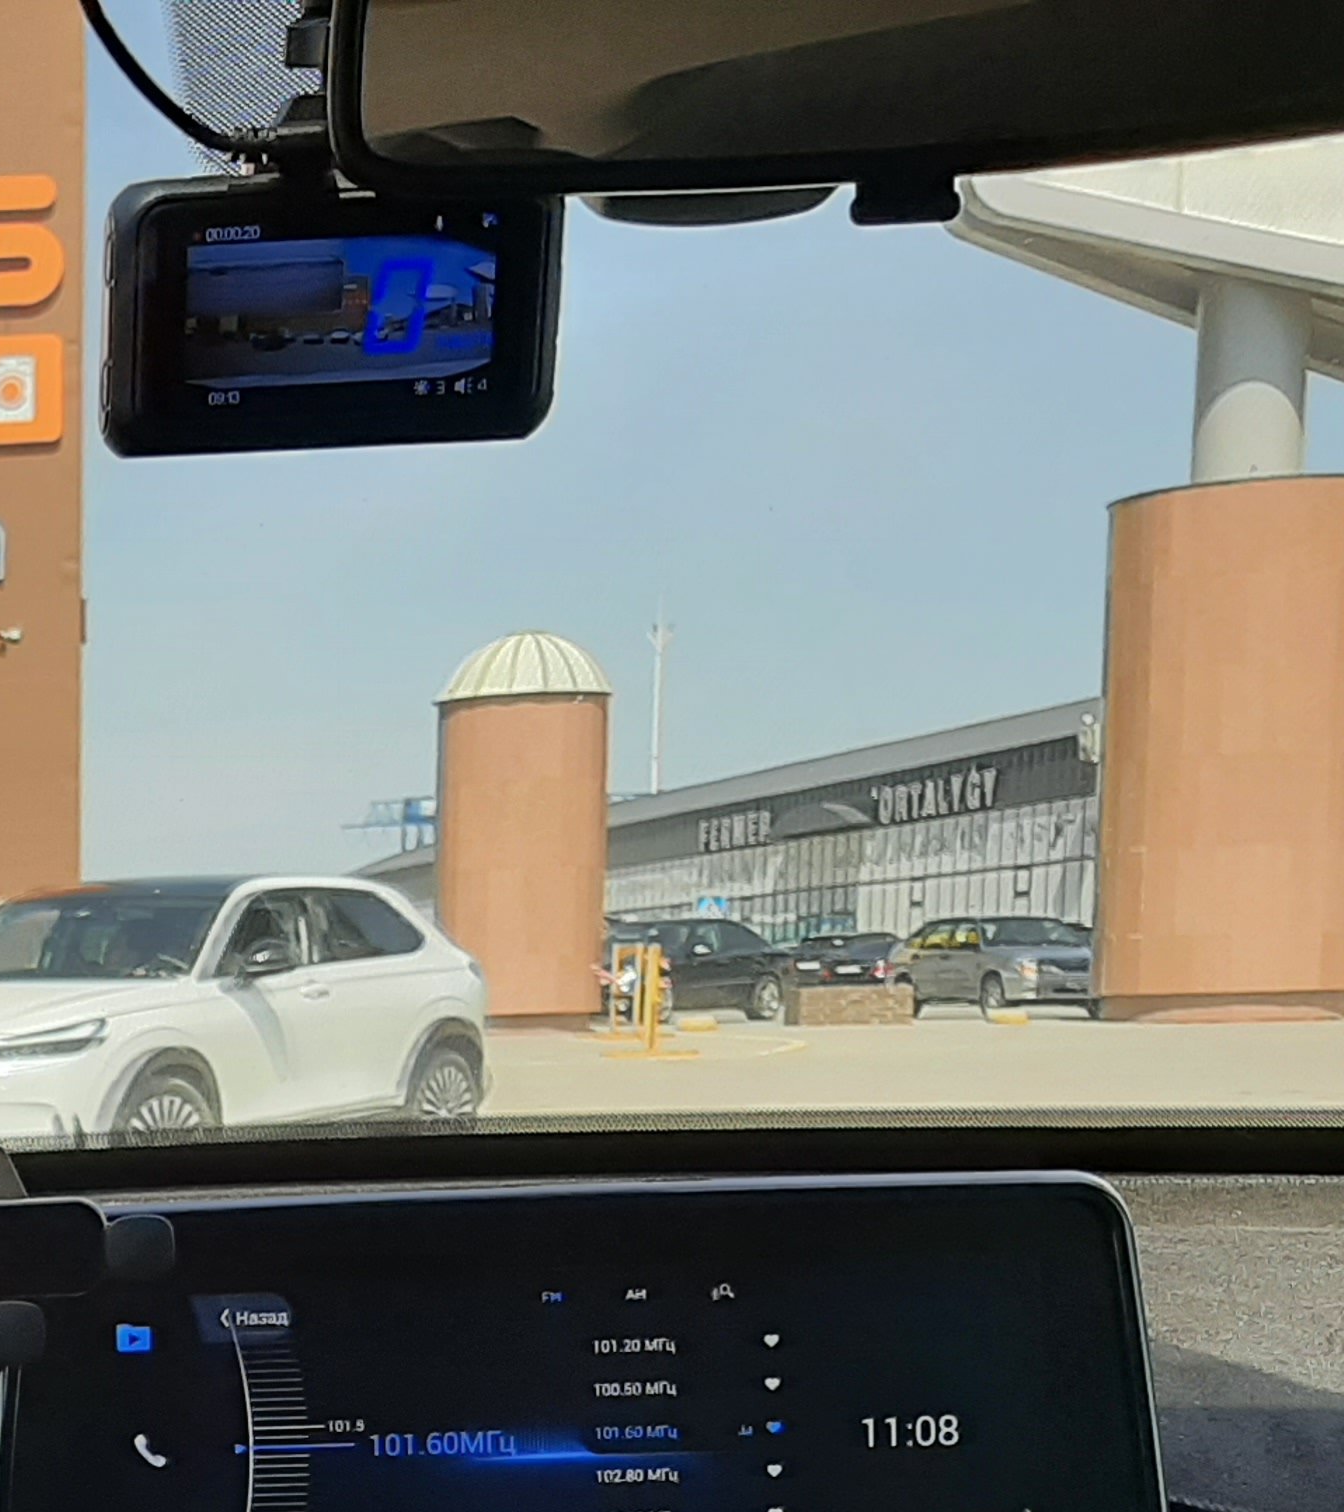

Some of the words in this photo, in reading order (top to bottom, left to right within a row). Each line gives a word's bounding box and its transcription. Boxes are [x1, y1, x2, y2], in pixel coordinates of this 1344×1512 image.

[235, 1311, 289, 1328] Назад
[644, 1338, 676, 1355] МГц
[645, 1381, 677, 1397] МГц
[646, 1424, 678, 1440] МГц
[860, 1414, 959, 1448] 11:08
[647, 1468, 679, 1483] МГц
